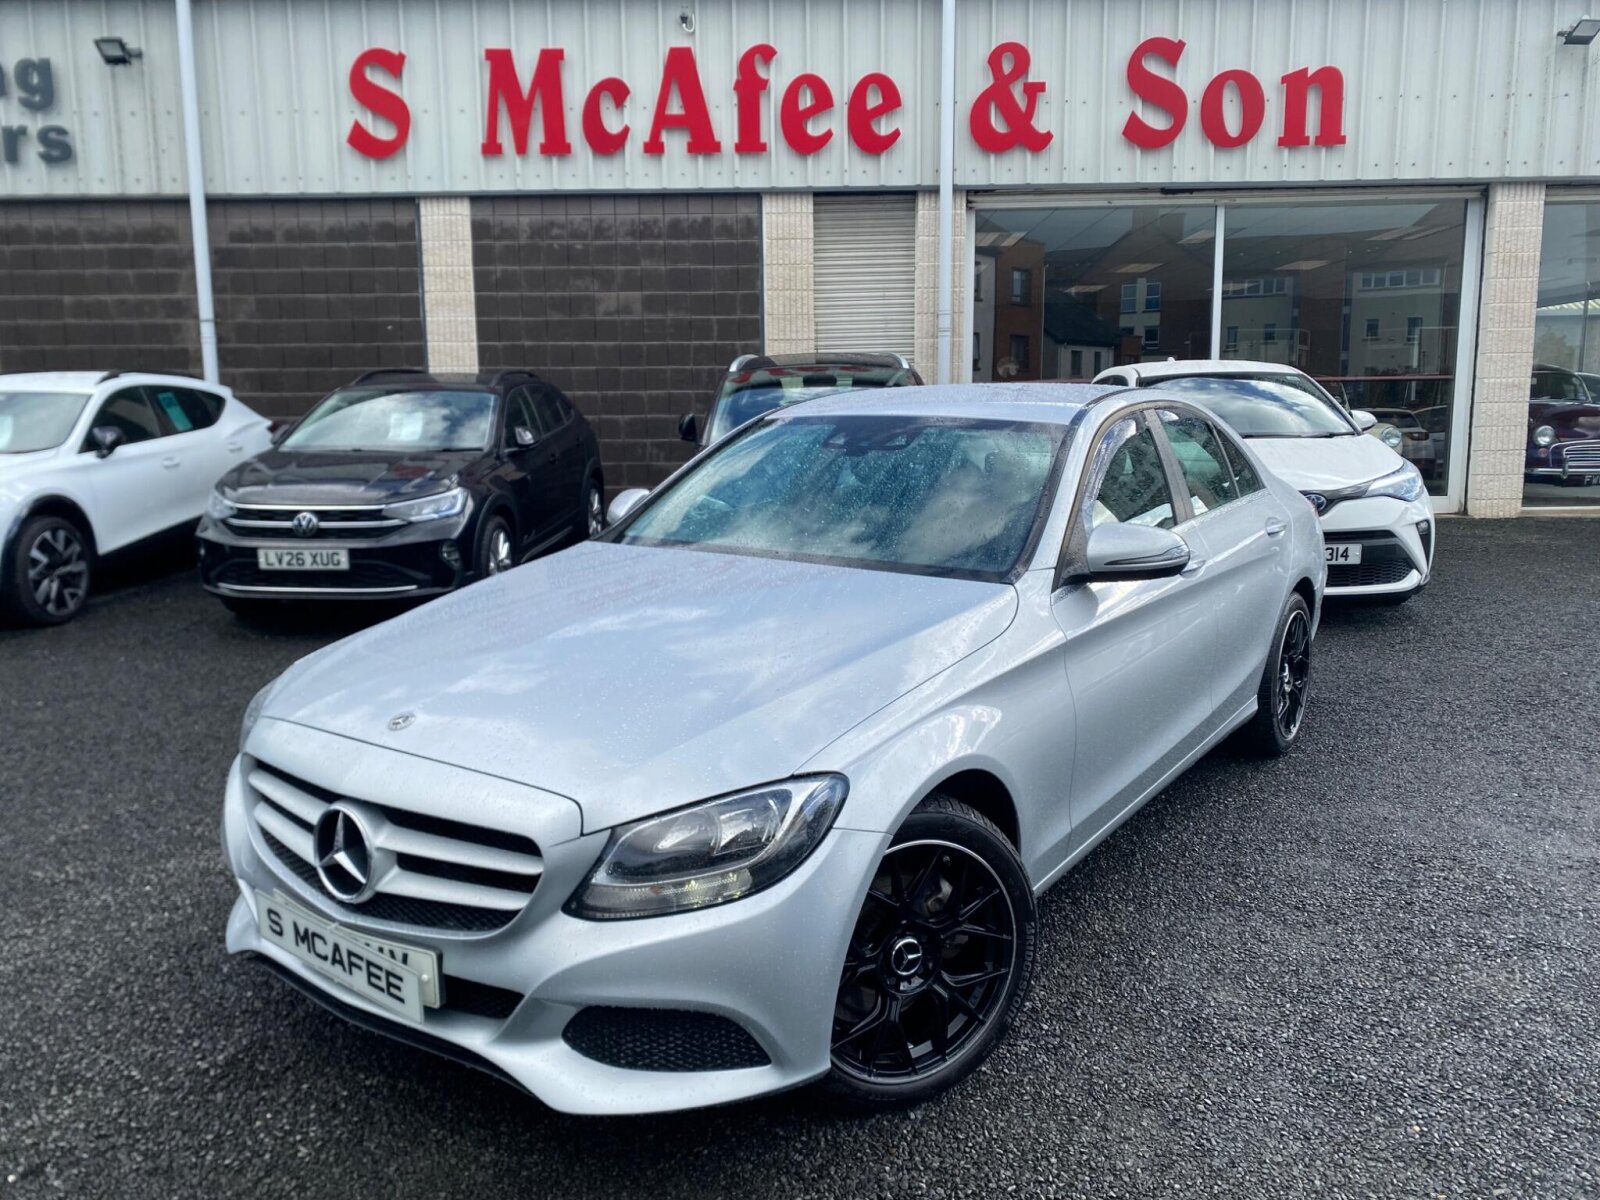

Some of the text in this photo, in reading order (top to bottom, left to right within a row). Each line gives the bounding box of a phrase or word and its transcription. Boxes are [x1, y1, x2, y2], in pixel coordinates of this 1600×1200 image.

[0, 57, 54, 112] g
[347, 36, 1347, 160] S McAfee & Son
[264, 551, 341, 567] LV26 XUG
[1325, 546, 1350, 562] 314
[266, 908, 284, 937] S
[292, 920, 406, 1005] MCAFEE
